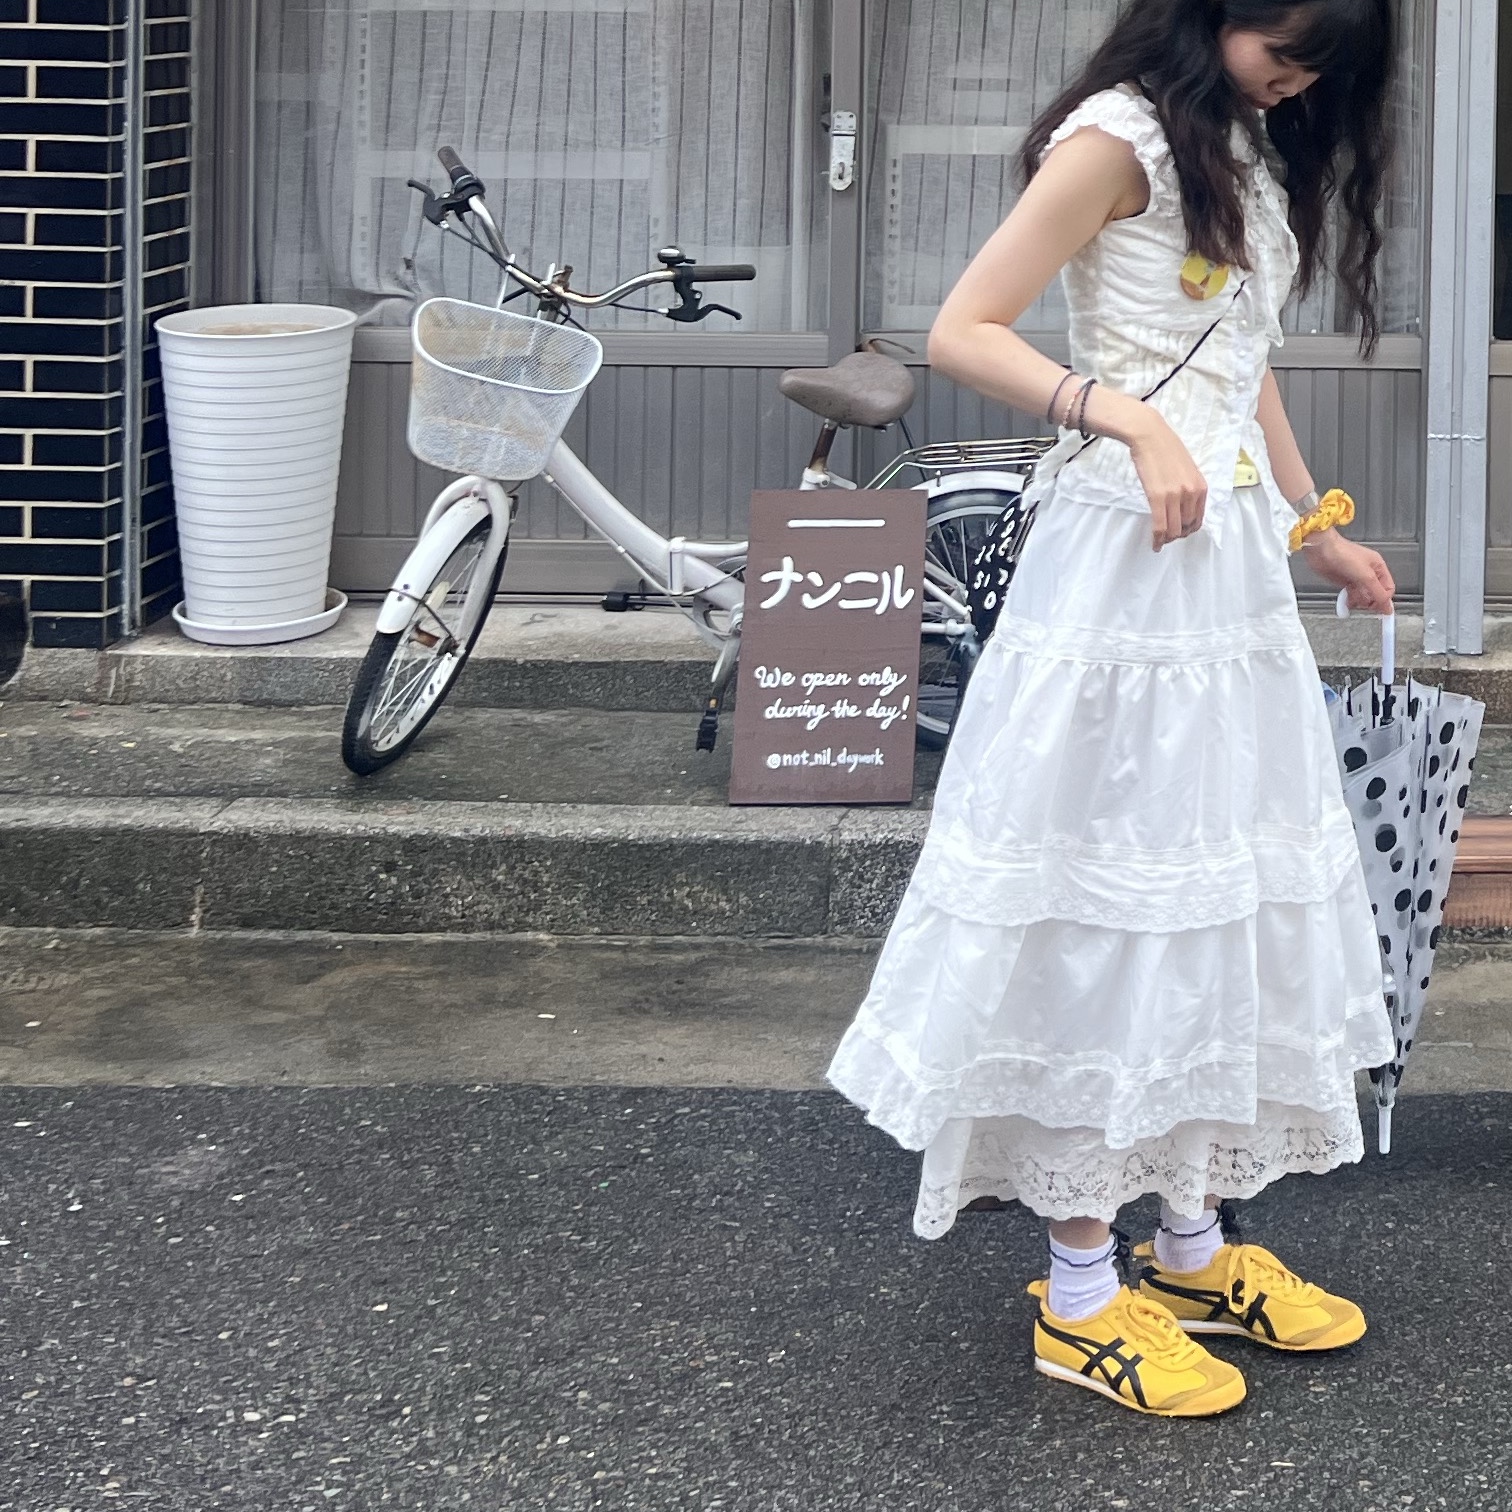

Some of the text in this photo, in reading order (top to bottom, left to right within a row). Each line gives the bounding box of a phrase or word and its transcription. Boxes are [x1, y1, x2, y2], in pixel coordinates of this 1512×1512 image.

[759, 555, 915, 615] ナンニル
[754, 665, 907, 697] We open only
[764, 694, 911, 731] during the day!
